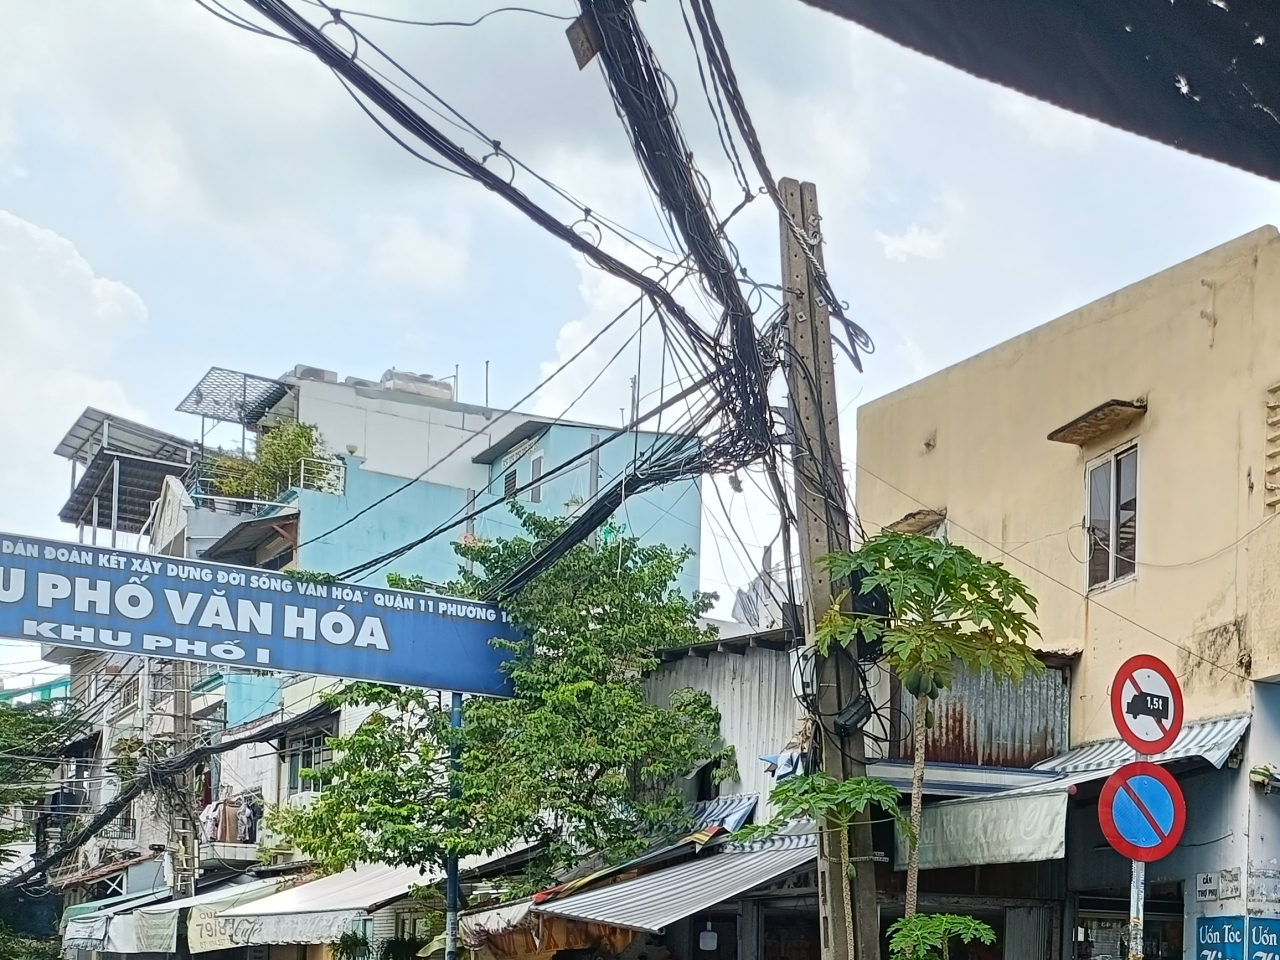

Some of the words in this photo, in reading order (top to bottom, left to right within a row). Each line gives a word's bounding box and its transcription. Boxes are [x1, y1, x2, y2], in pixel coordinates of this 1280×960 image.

[2, 540, 39, 558] DÂN
[44, 546, 93, 565] ĐOÀN
[99, 551, 127, 570] KẾT
[130, 557, 163, 575] XÂY
[166, 563, 213, 583] DỰNG
[217, 569, 246, 587] ĐỜI
[249, 573, 293, 593] SỐNG
[373, 593, 414, 611] QUẬN
[419, 599, 434, 613] 11
[438, 601, 497, 622] PHƯỜNG
[37, 575, 154, 619] PHỐ
[163, 588, 273, 635] VĂN
[284, 603, 390, 650] HÓA
[23, 619, 132, 646] KHU
[142, 639, 246, 660] PHỐ
[1199, 925, 1220, 944] Uốn
[1222, 924, 1242, 943] Tóc
[1251, 925, 1278, 946] Uốn
